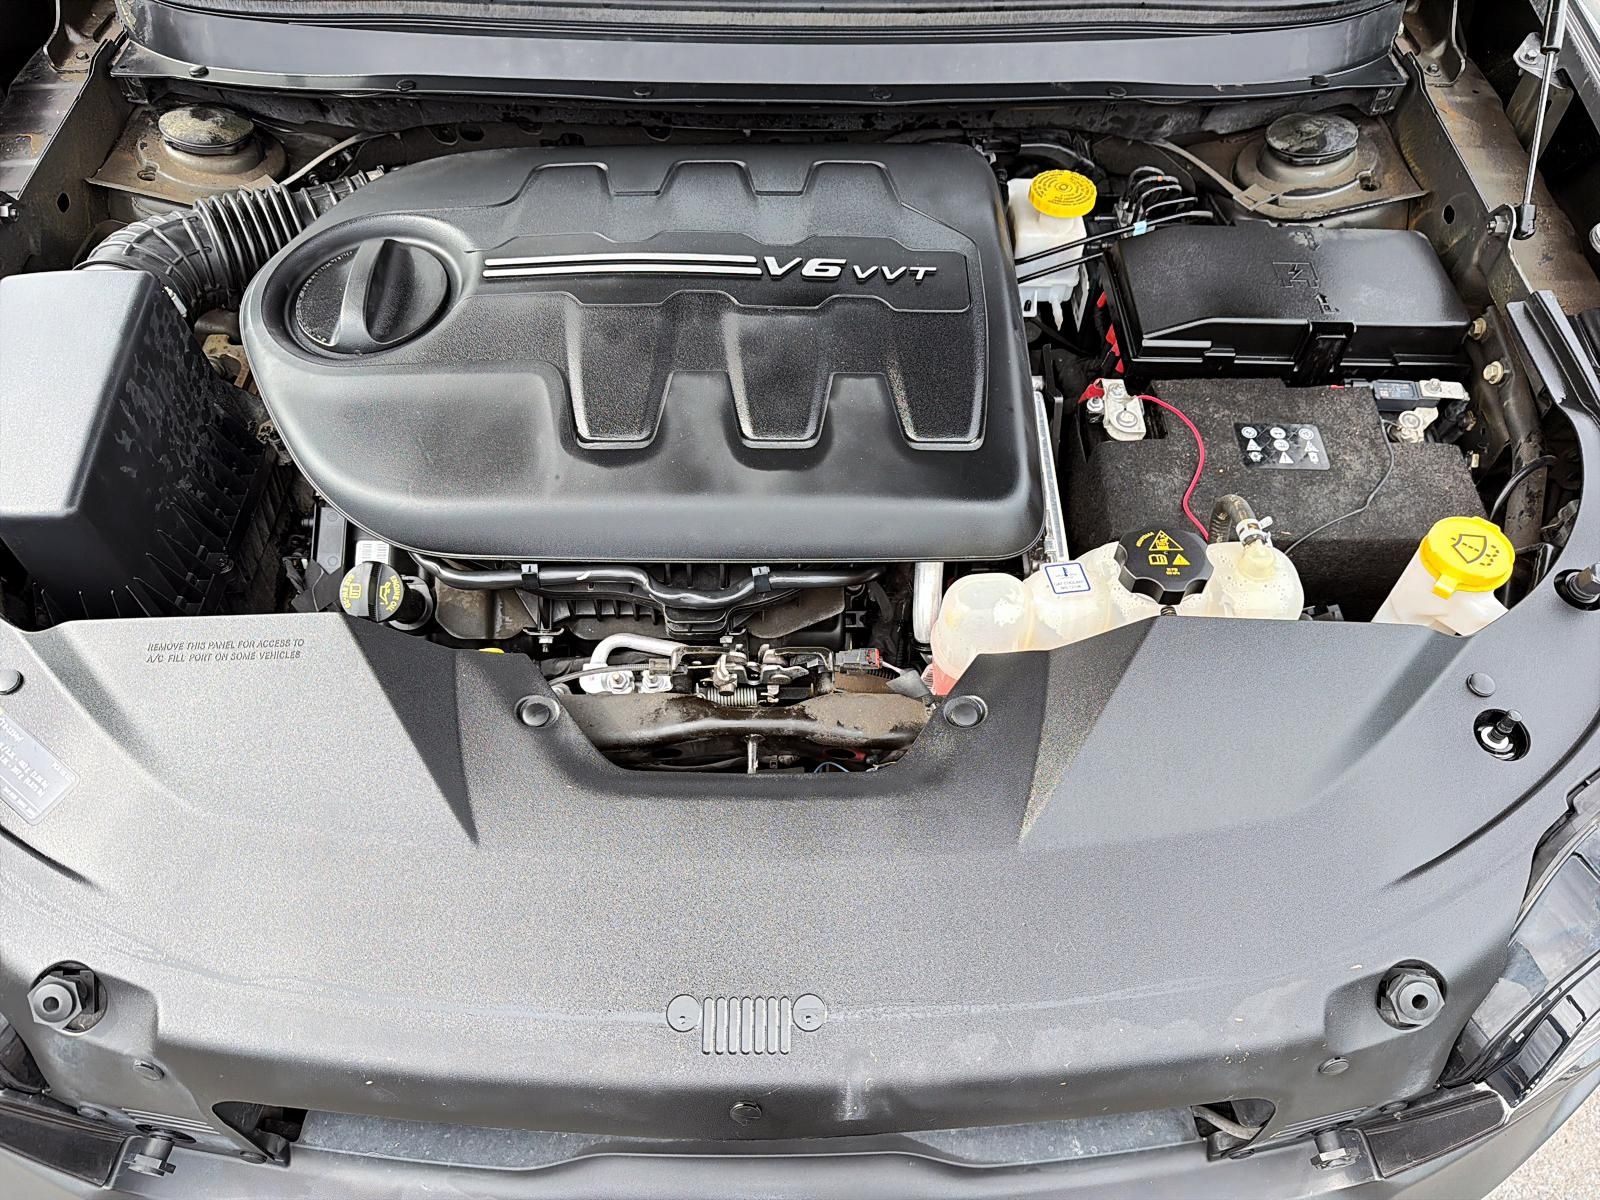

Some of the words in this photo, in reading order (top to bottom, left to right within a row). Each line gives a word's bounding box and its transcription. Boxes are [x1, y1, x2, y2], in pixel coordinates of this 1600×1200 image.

[764, 256, 847, 279] V6
[853, 265, 937, 282] VVT
[389, 574, 401, 600] ENGINE
[386, 600, 397, 612] OIL
[147, 642, 185, 652] REMOVE
[187, 641, 206, 650] THIS
[208, 640, 235, 650] PANEL
[237, 639, 256, 648] FOR
[256, 639, 291, 648] ACCESS
[292, 638, 305, 647] TO
[145, 653, 164, 663] A/C
[167, 653, 185, 662] FILL
[188, 652, 213, 662] PORT
[215, 652, 229, 661] ON
[230, 650, 256, 660] SOME
[259, 649, 301, 660] VEHICLES
